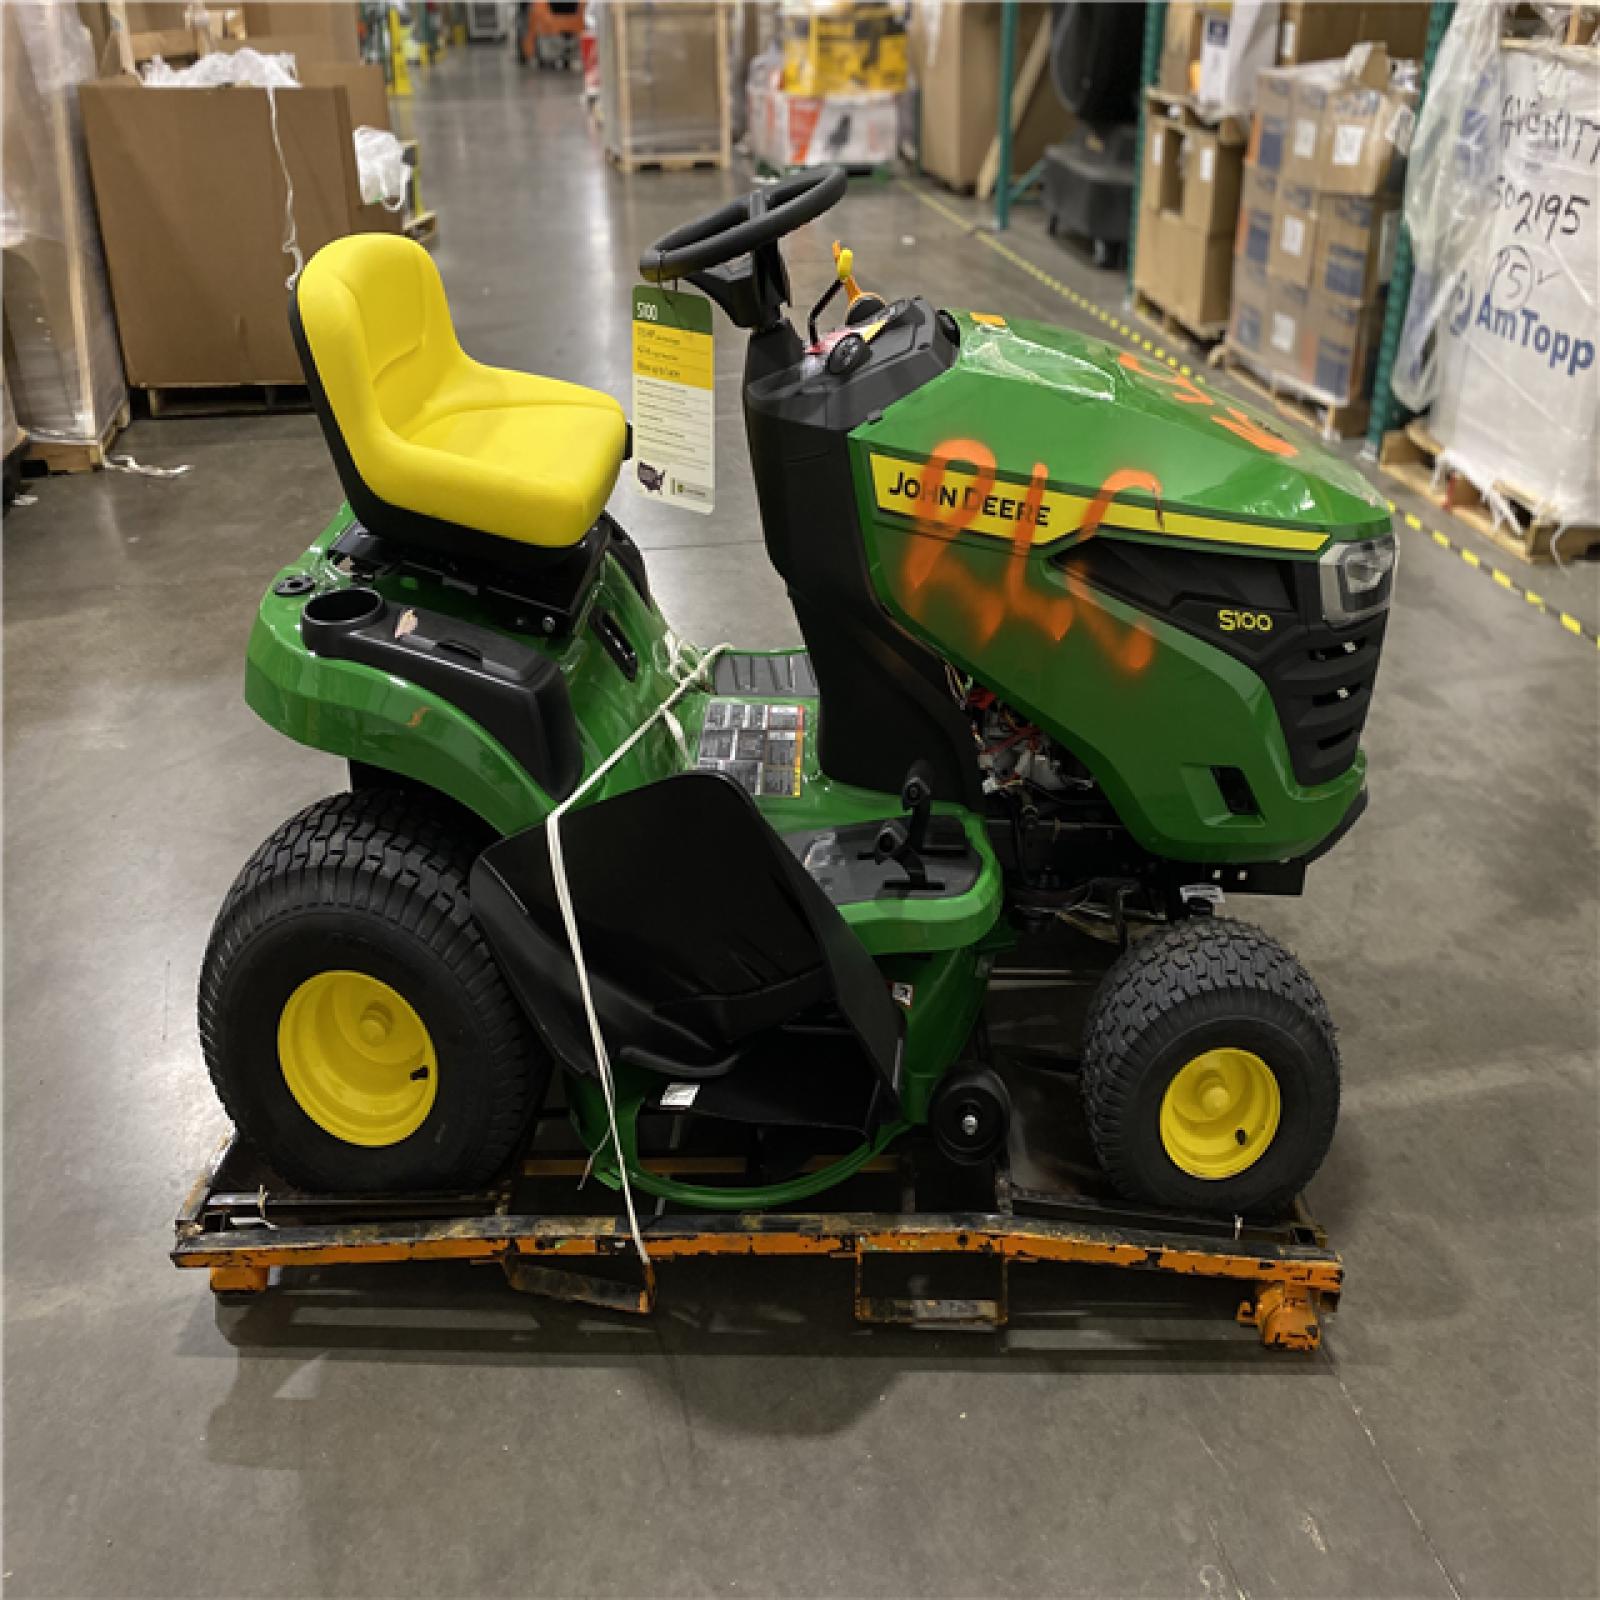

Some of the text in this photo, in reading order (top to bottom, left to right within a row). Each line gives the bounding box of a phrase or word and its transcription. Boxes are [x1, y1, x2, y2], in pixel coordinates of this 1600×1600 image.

[1474, 290, 1596, 377] AmTopp
[889, 472, 1051, 527] JOHN DEERE
[1217, 608, 1274, 631] S100
